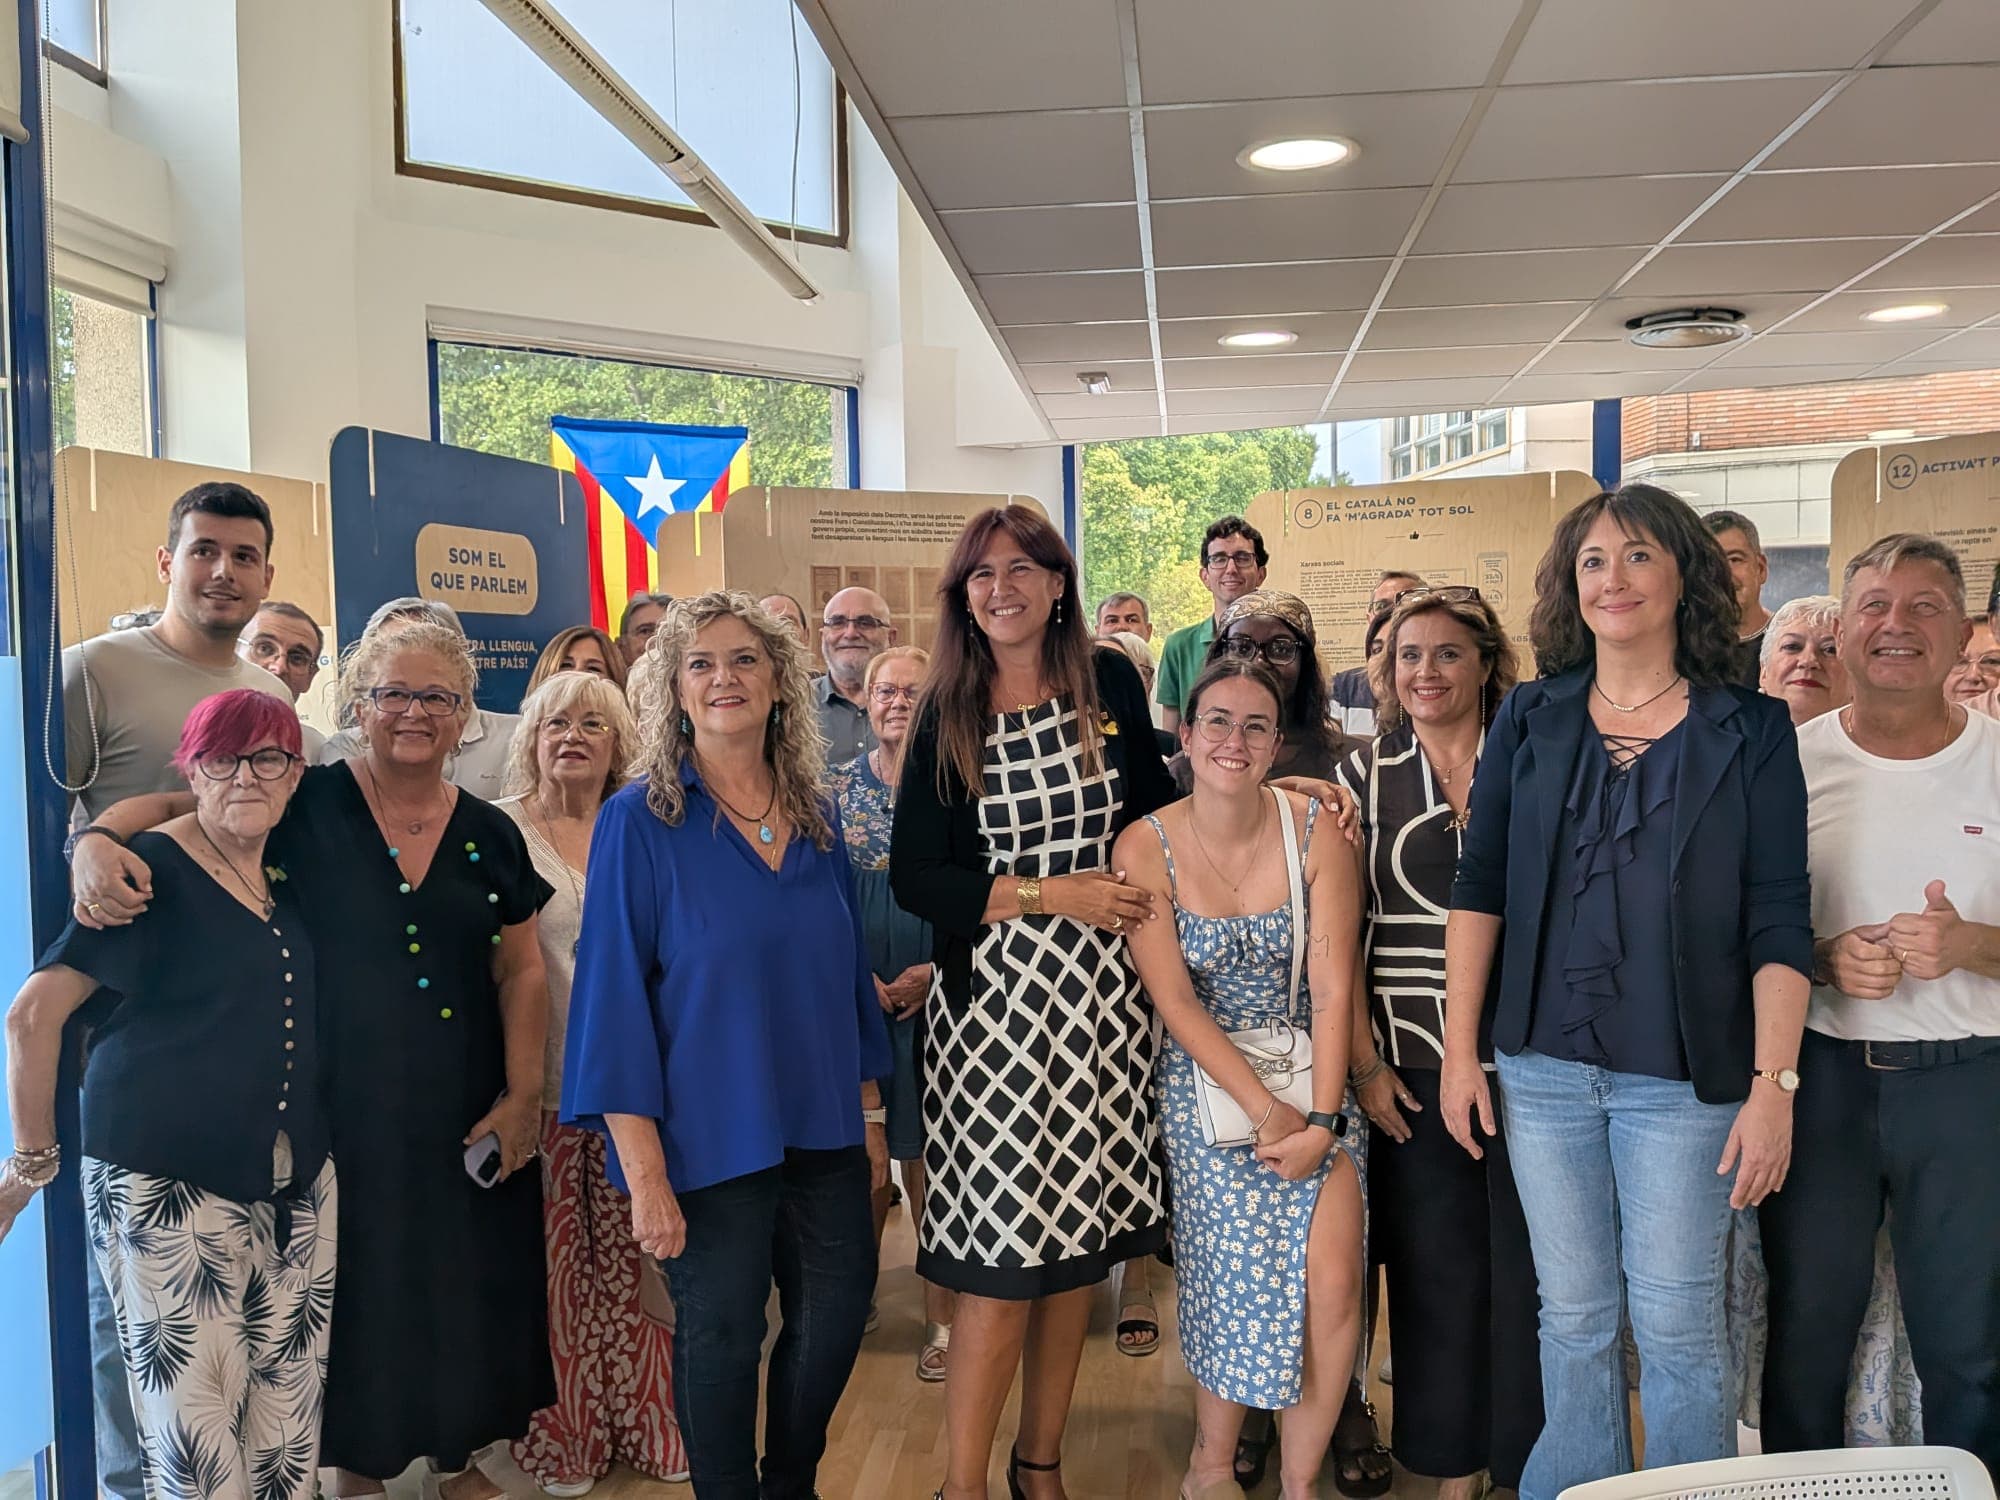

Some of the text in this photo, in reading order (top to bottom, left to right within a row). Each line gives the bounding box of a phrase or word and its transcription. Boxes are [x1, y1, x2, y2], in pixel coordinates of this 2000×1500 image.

[1892, 464, 1911, 478] 12
[1921, 457, 1985, 474] ACTIVA'T
[1326, 496, 1416, 510] EL CATALÀ NO
[1304, 508, 1313, 519] 8
[1326, 513, 1341, 522] FA
[1418, 507, 1444, 517] TOT
[1448, 505, 1474, 515] SOL
[449, 547, 506, 569] SOM EL
[431, 572, 527, 595] QUE PARLEM
[489, 639, 538, 654] LLENGUA,
[500, 655, 528, 669] PAÍS!
